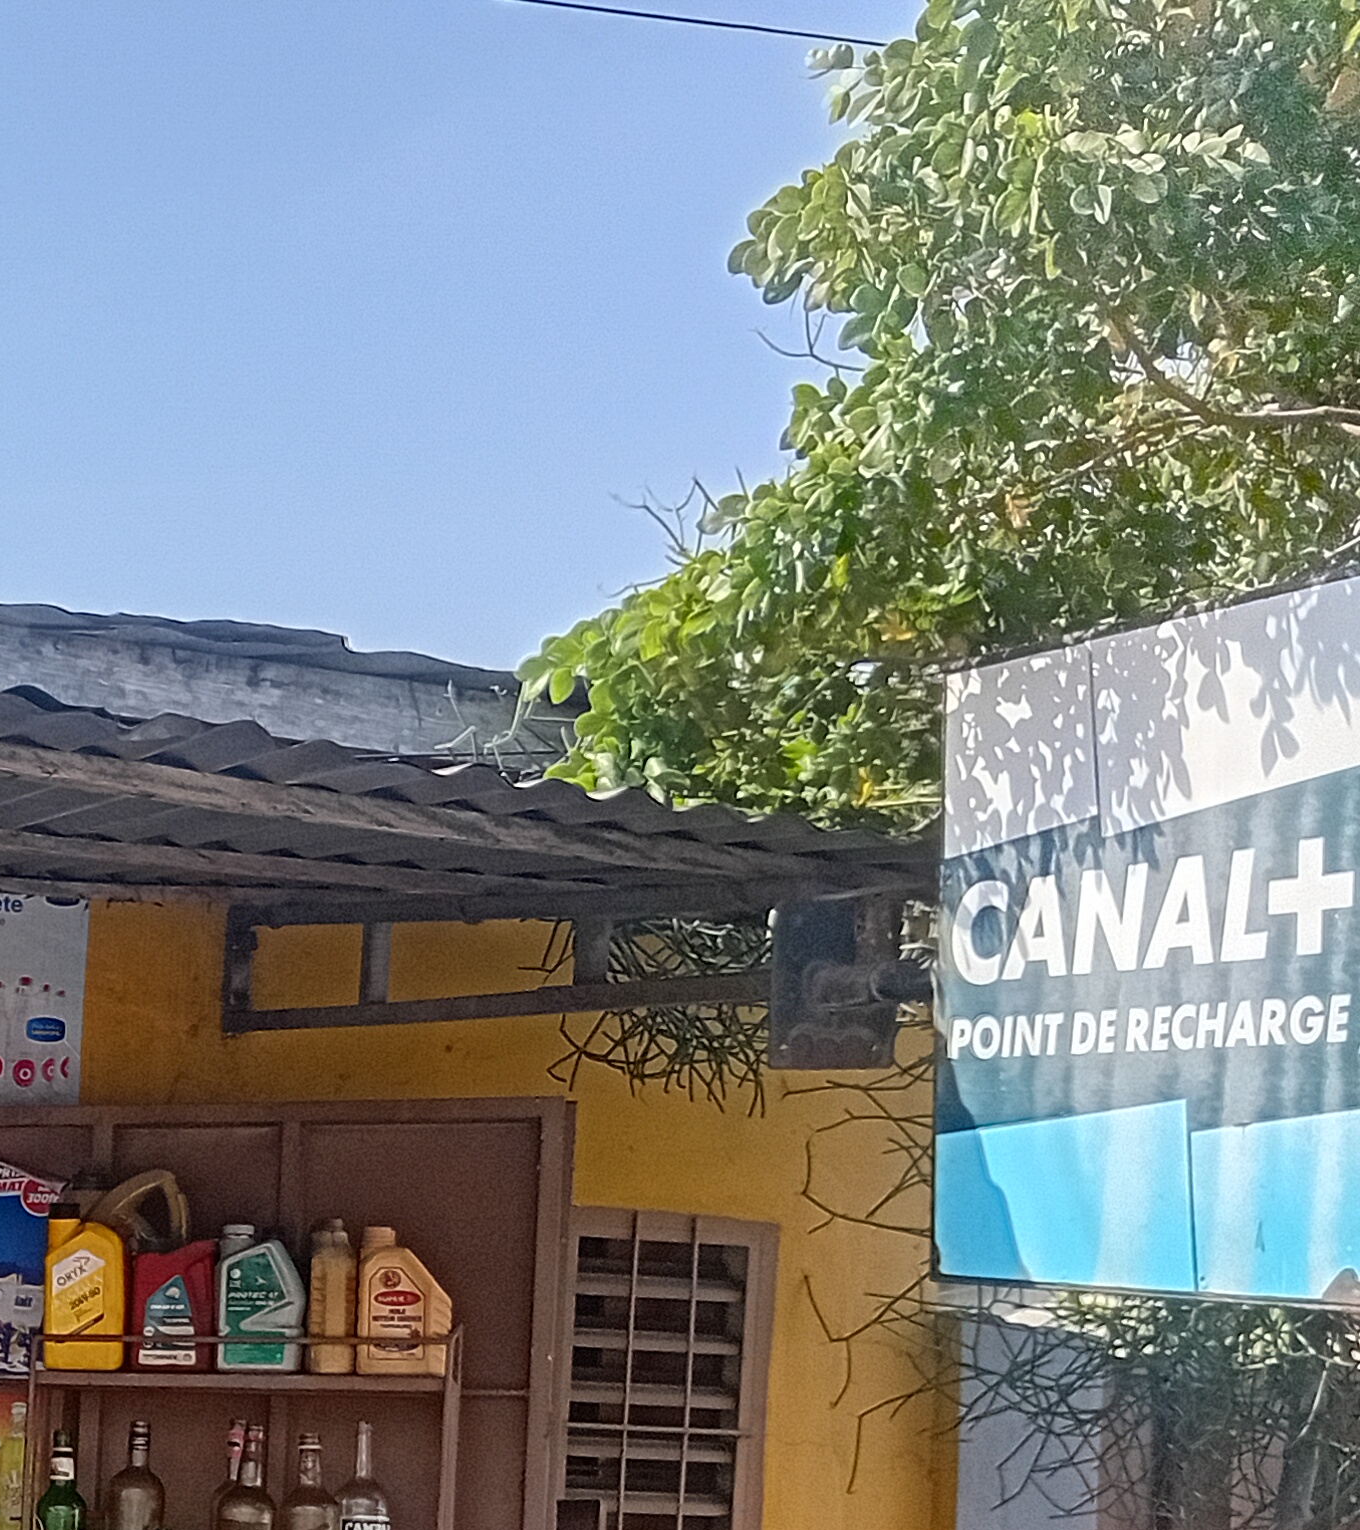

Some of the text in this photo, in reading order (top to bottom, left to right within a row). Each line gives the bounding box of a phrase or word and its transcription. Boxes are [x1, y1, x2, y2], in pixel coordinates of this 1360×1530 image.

[950, 837, 1356, 985] CANAL+
[947, 994, 1352, 1060] POINT DE RECHARGE
[56, 1262, 89, 1288] ORYX
